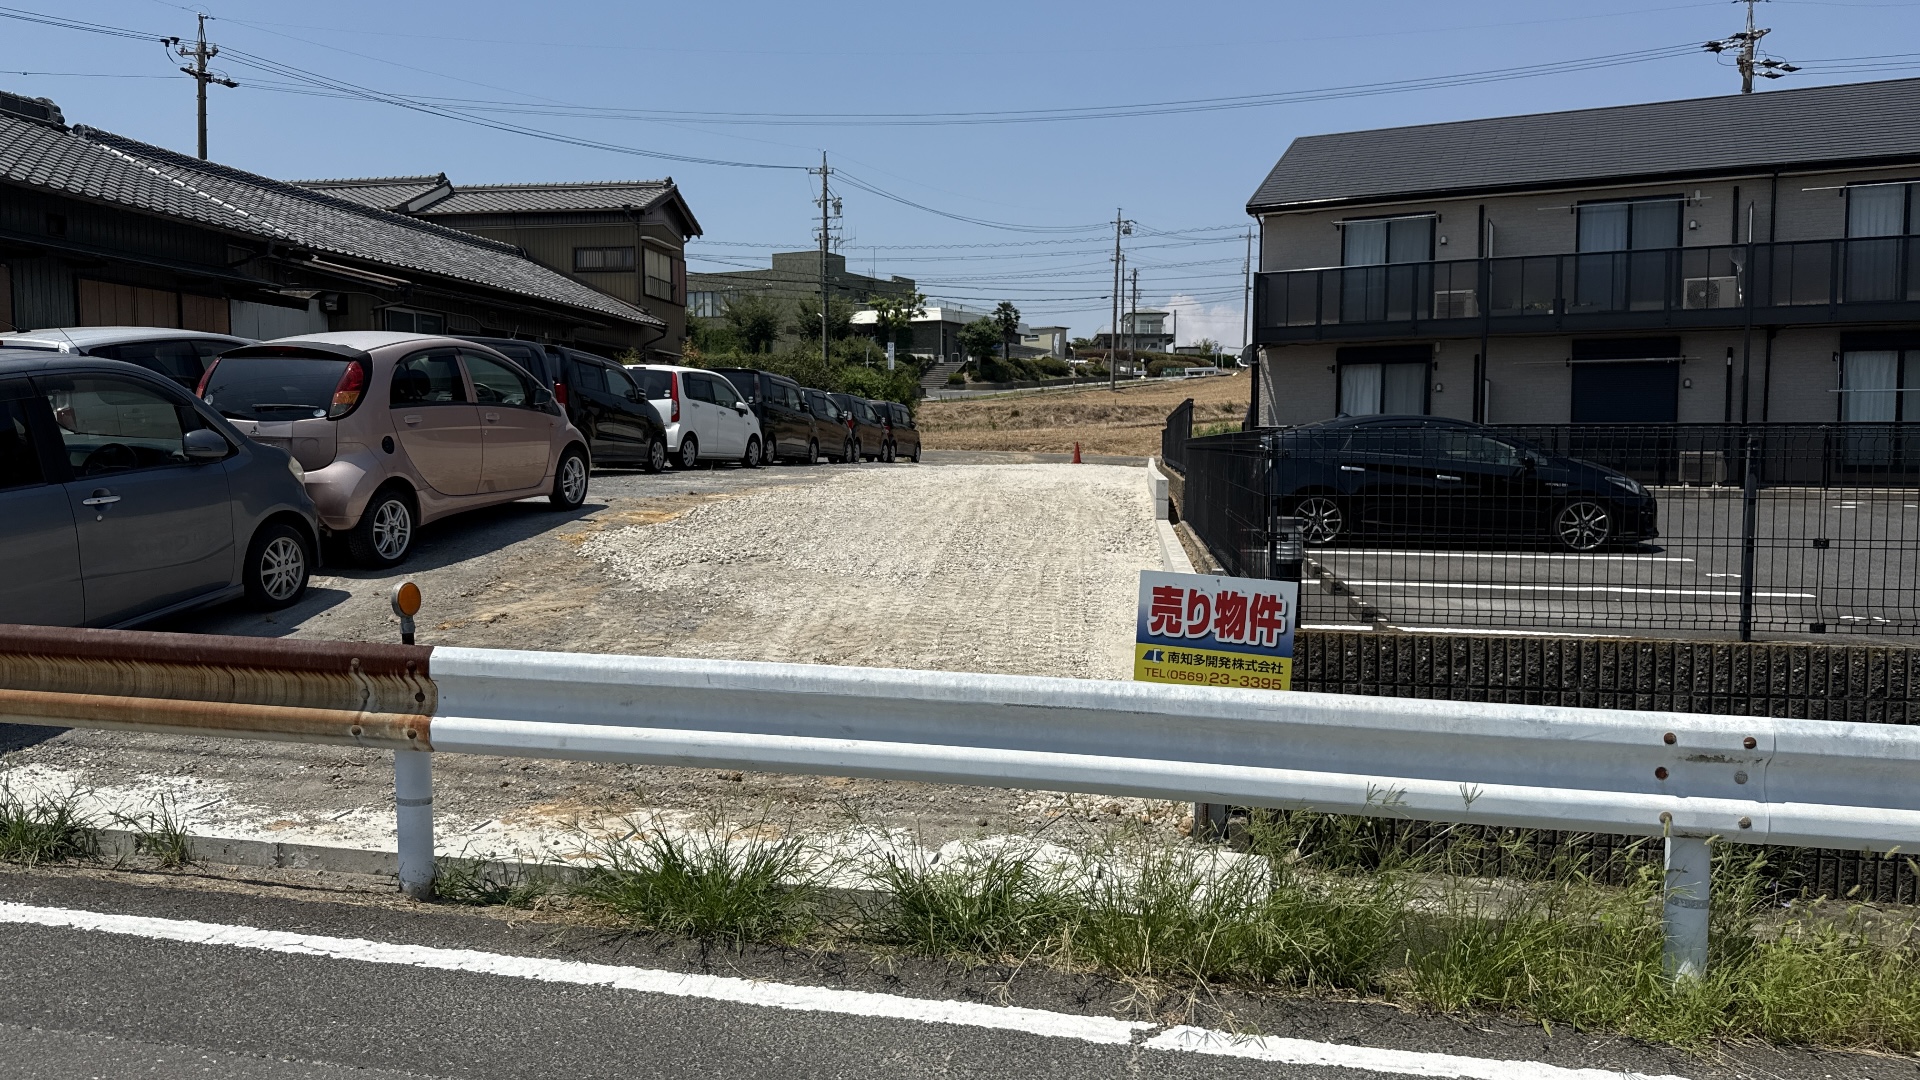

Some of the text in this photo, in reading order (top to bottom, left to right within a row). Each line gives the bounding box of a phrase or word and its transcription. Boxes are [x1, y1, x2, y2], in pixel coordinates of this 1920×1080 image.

[1149, 585, 1284, 645] 売り物件
[1167, 651, 1284, 675] 南知多開発株式会社
